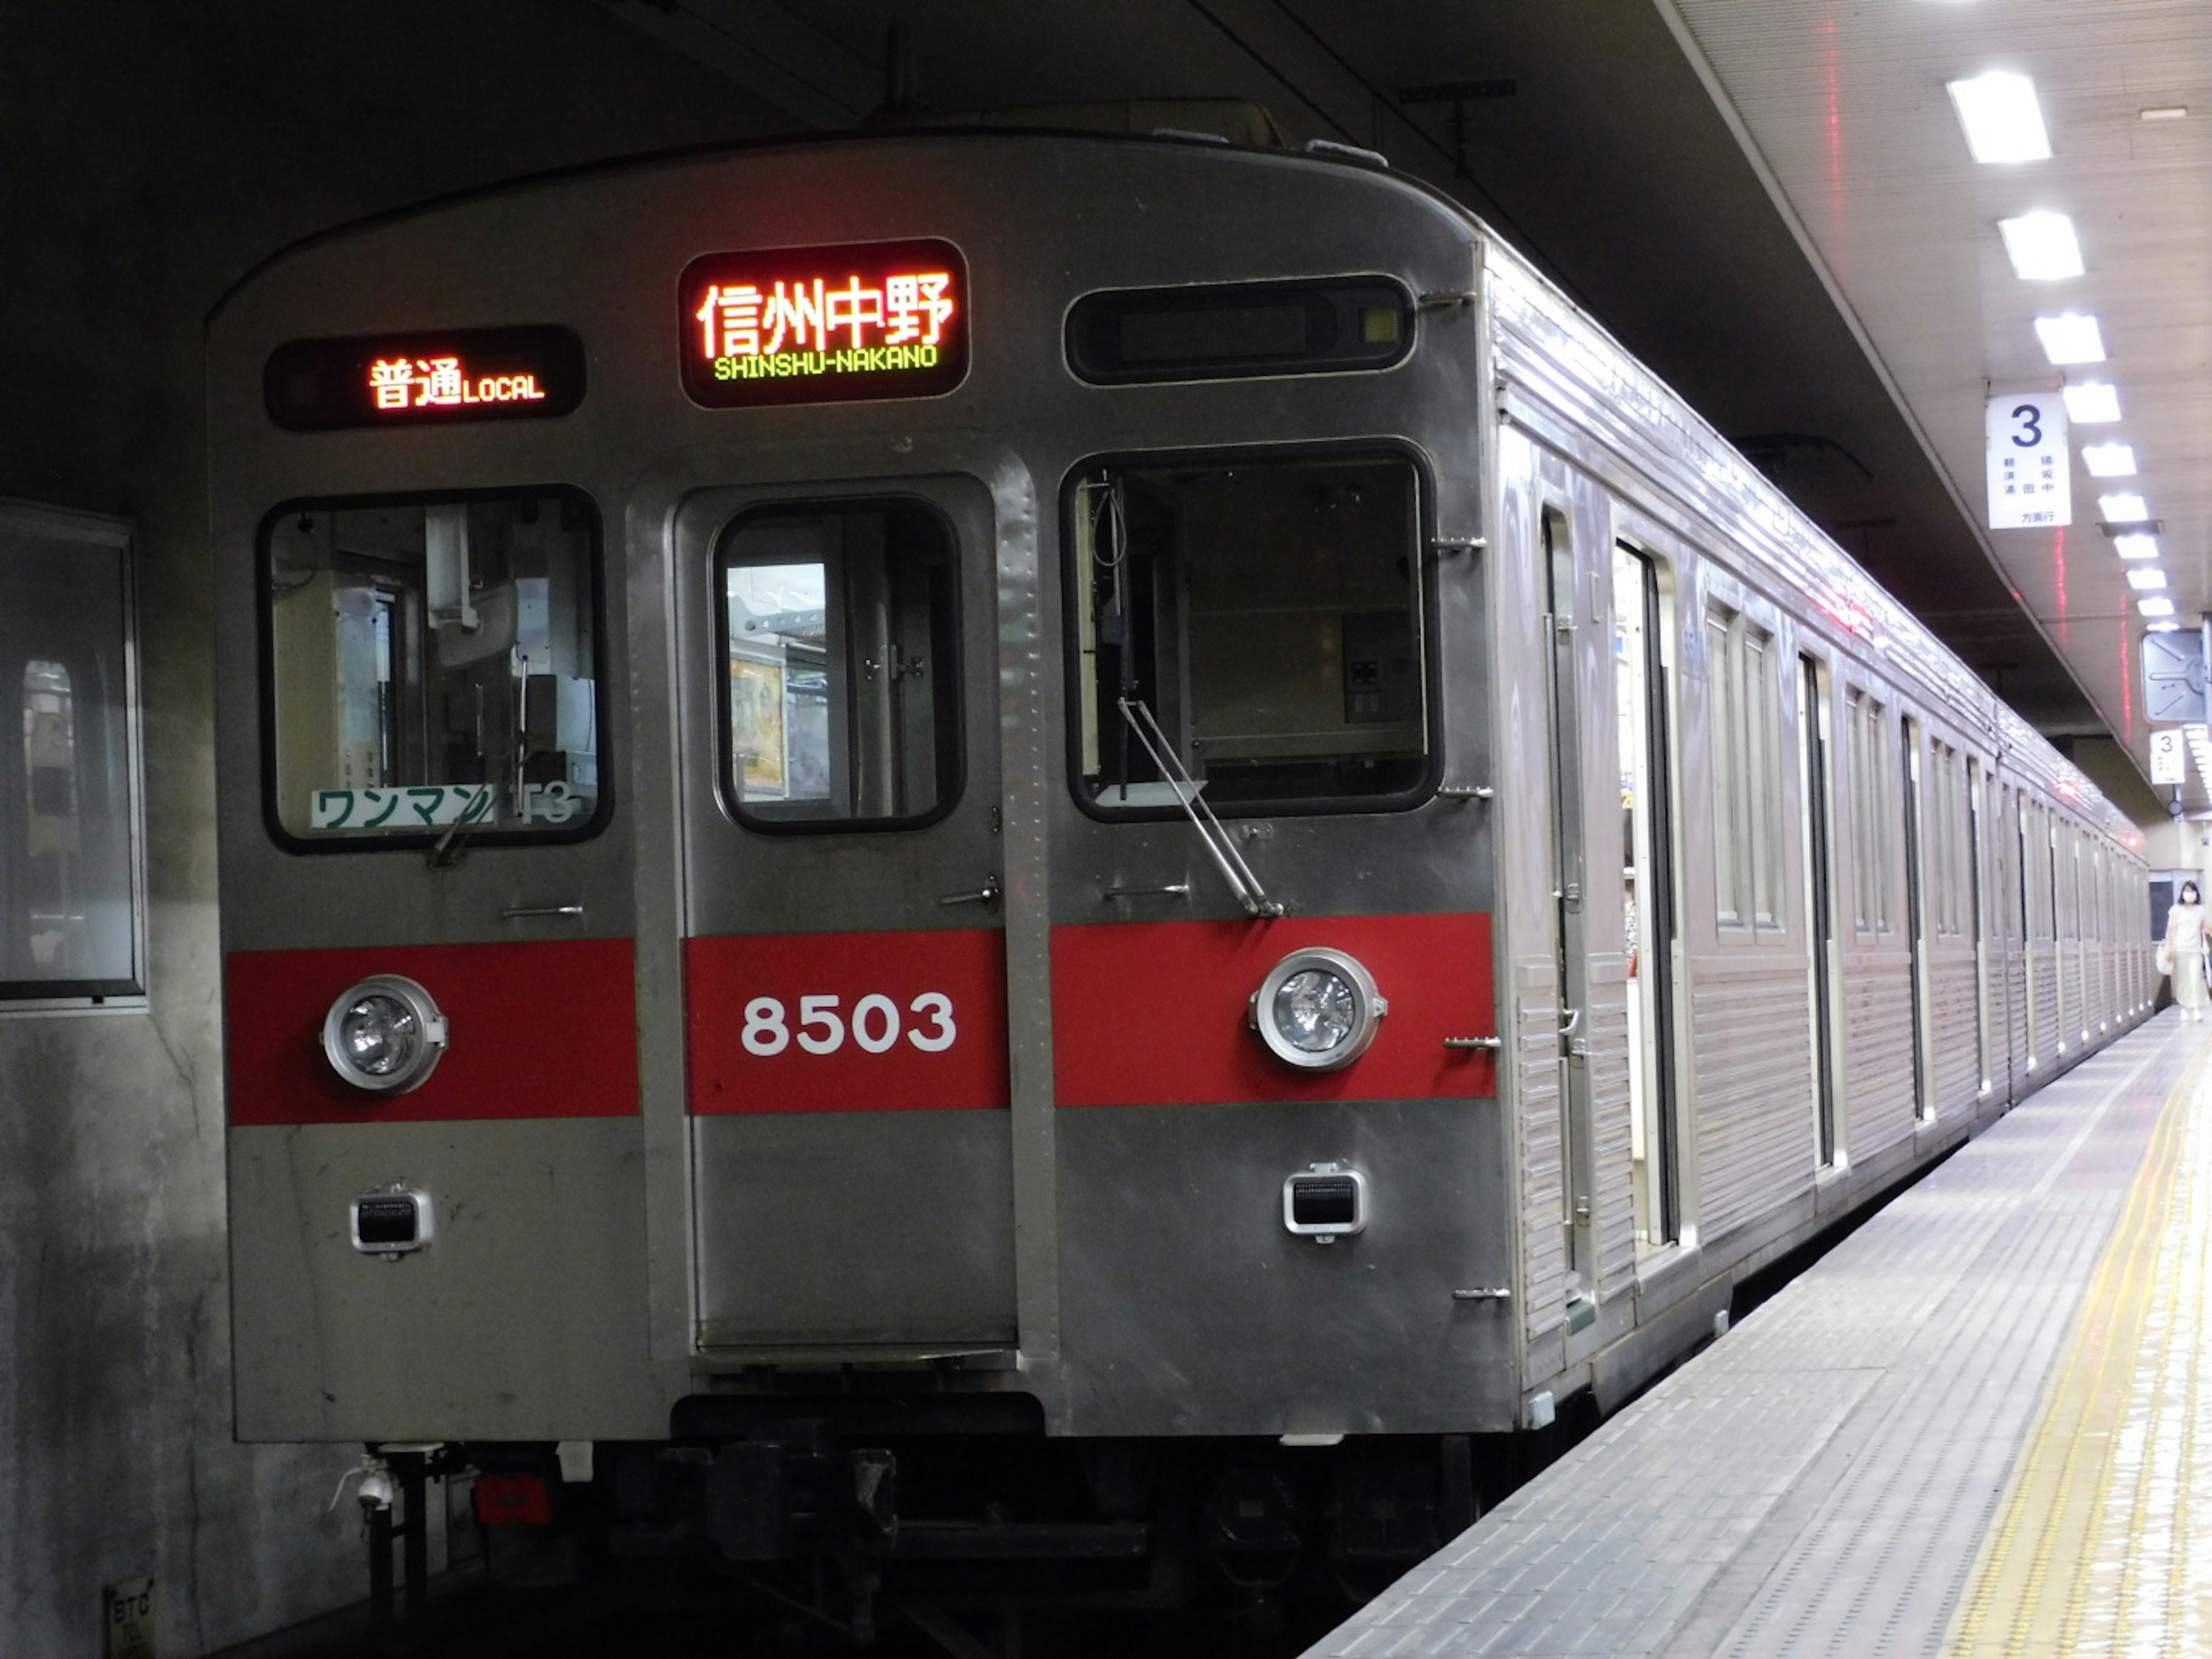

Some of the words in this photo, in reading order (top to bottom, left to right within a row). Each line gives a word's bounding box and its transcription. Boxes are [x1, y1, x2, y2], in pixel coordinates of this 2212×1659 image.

[696, 271, 953, 359] 信州中野
[369, 358, 463, 410] 普通
[463, 375, 545, 404] LOCAL
[714, 344, 938, 381] SHINSHU-NAKANO
[2012, 404, 2042, 448] 3
[2160, 735, 2173, 753] 3
[319, 786, 488, 828] ワンマン
[741, 991, 957, 1056] 8503
